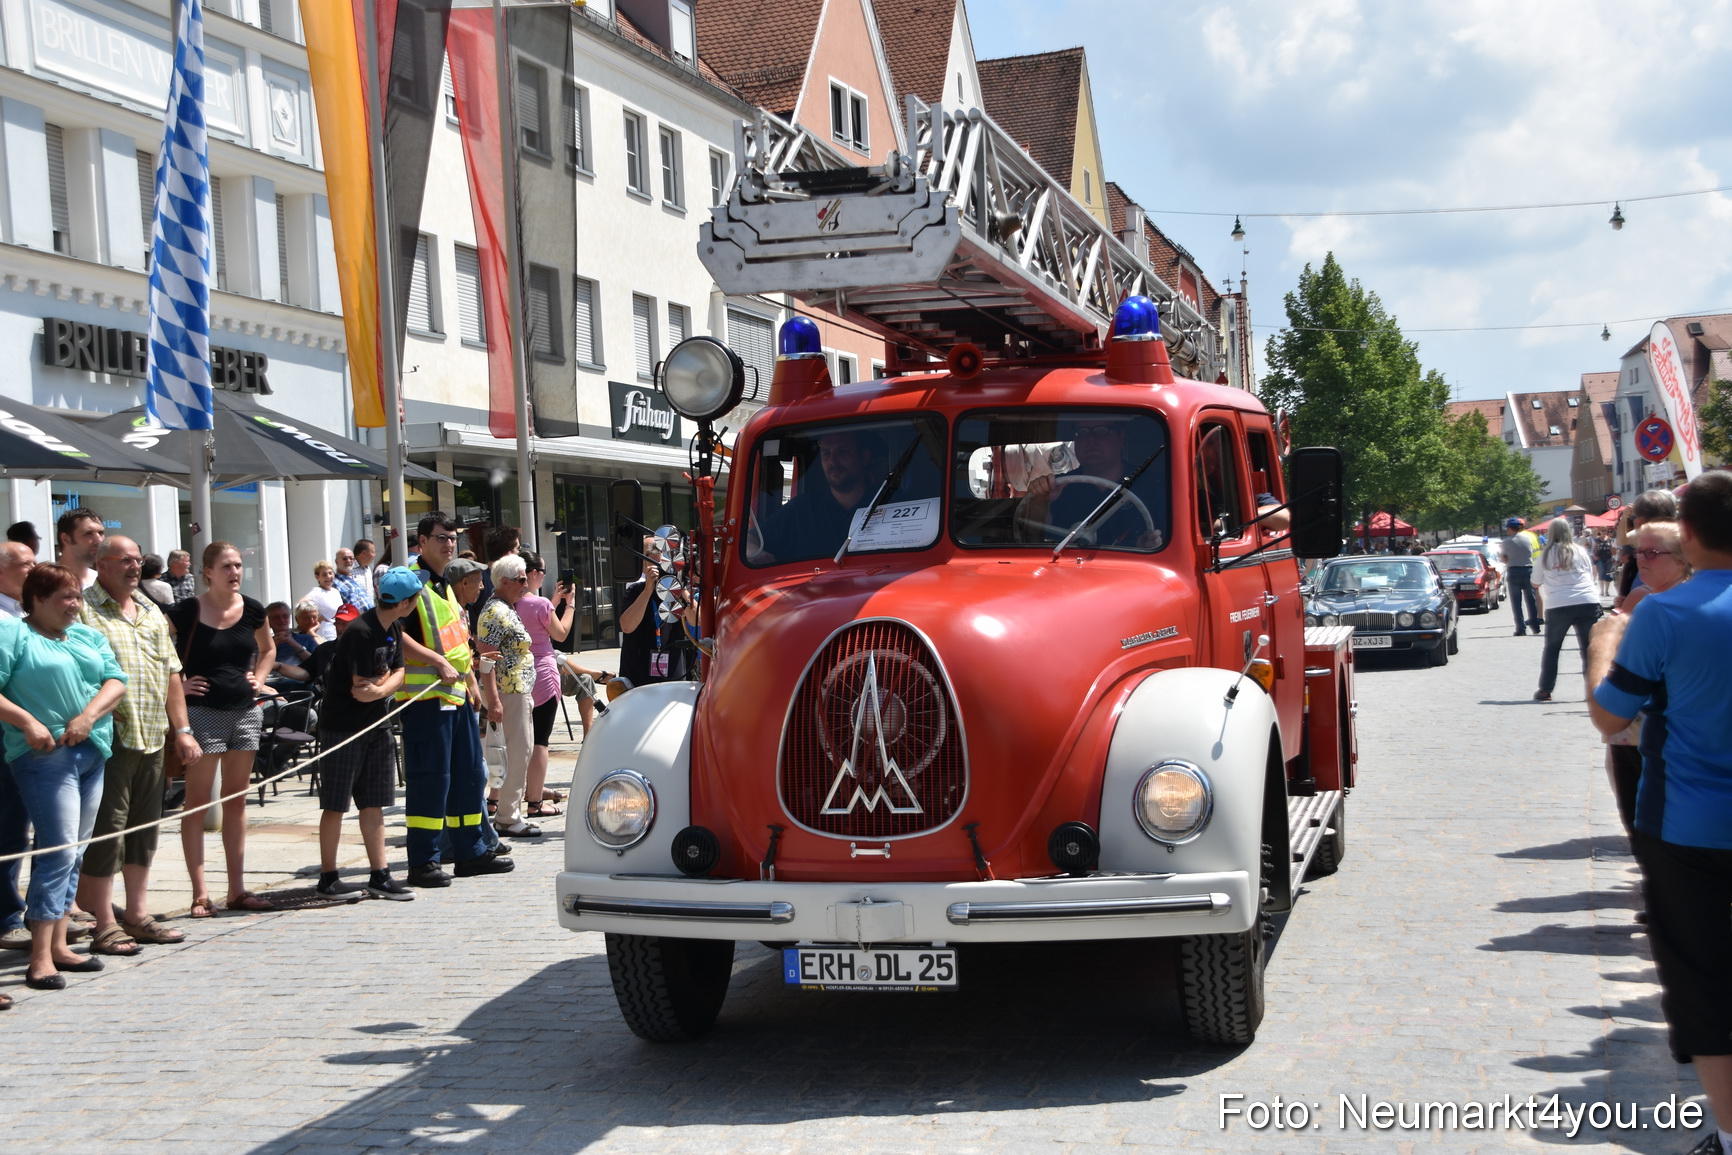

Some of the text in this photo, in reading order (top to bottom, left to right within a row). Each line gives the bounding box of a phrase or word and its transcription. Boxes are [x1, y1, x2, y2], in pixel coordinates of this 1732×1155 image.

[41, 7, 144, 80] BRILLEN
[43, 317, 274, 396] BRILLE EBER
[891, 506, 921, 519] 227
[1609, 499, 1619, 507] 30
[788, 969, 796, 978] D
[800, 953, 954, 982] ERH DL 25
